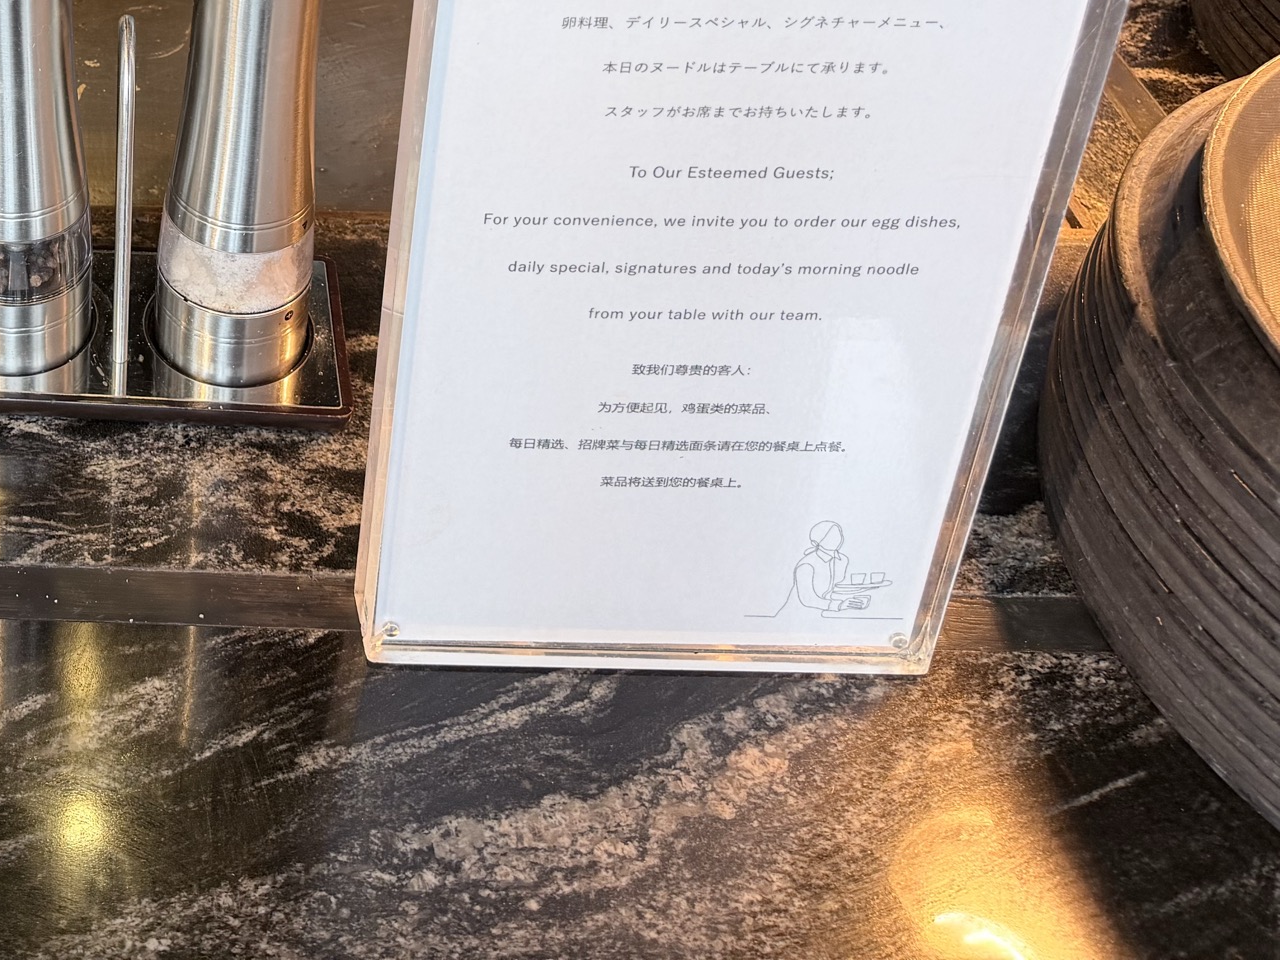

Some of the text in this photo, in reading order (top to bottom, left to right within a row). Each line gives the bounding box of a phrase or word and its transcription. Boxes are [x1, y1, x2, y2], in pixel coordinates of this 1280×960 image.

[629, 165, 835, 182] To Our Esteemed Guests;
[483, 212, 961, 231] For your convenience, we invite you to order our egg dishes,
[507, 260, 545, 276] daily
[549, 261, 610, 276] special,
[614, 261, 697, 277] signatures
[701, 262, 732, 275] and
[797, 263, 863, 278] morning
[866, 262, 920, 276] noodle
[588, 307, 822, 322] from your table with our team.
